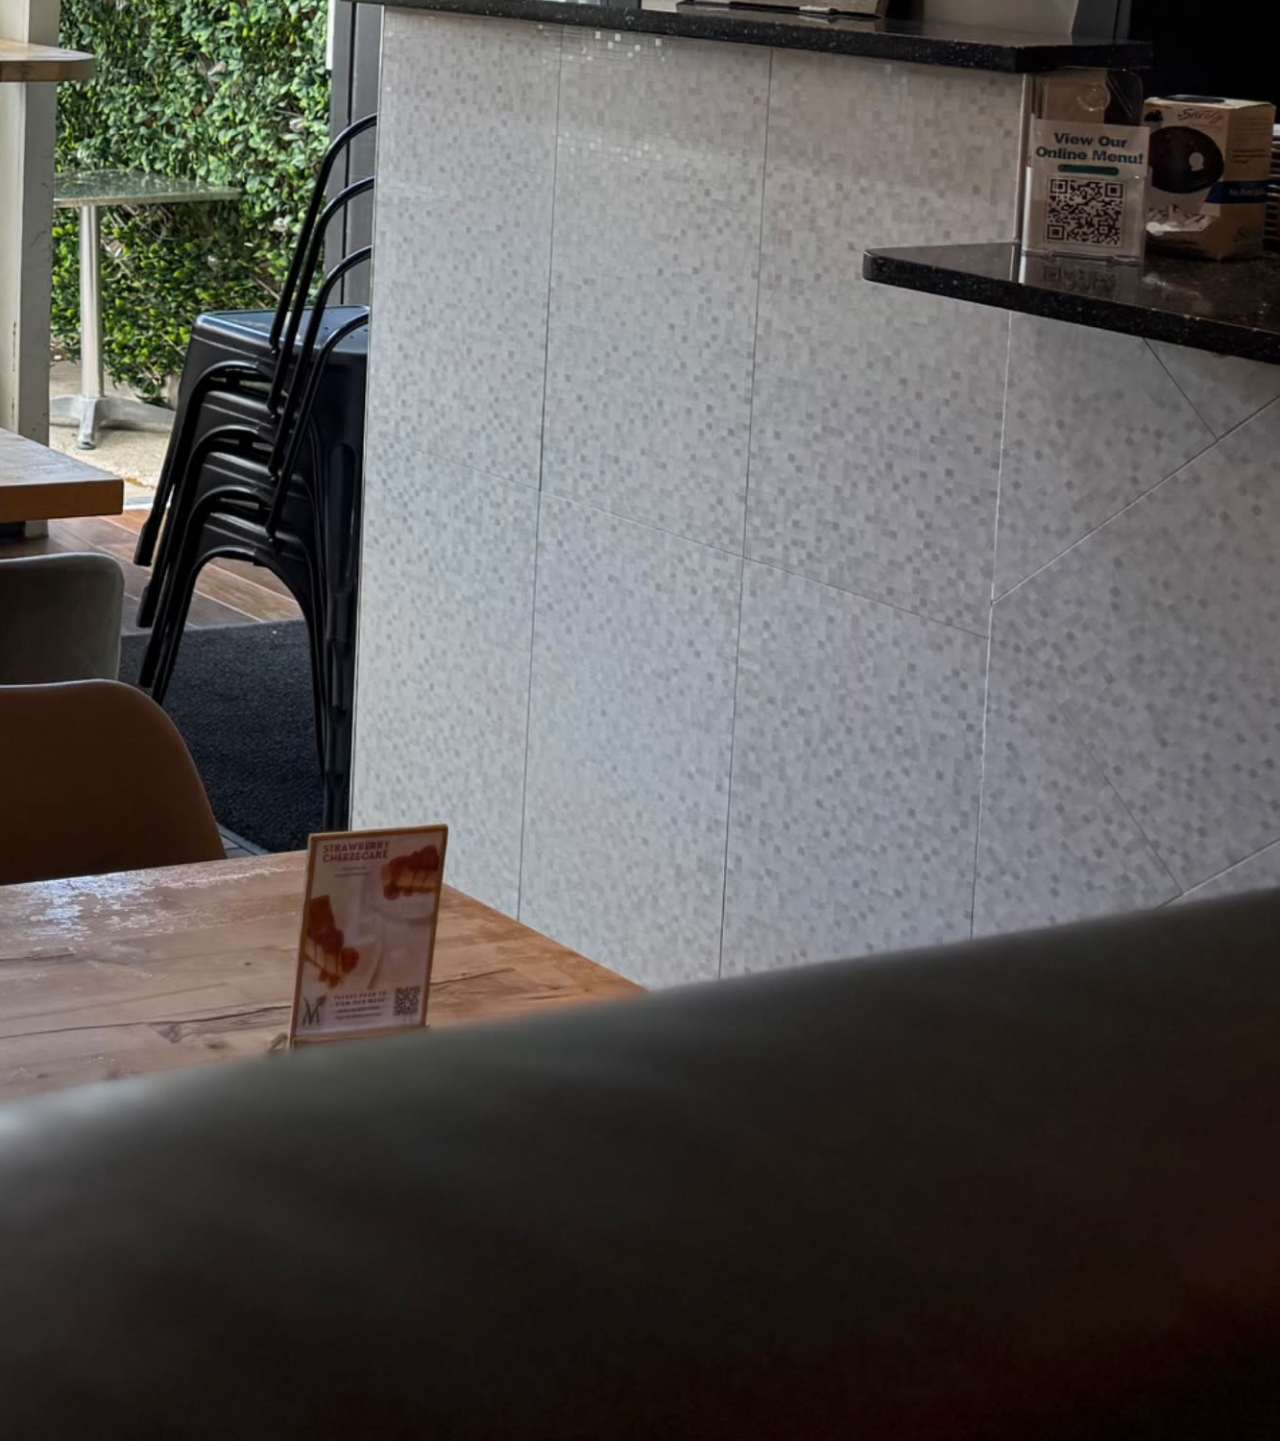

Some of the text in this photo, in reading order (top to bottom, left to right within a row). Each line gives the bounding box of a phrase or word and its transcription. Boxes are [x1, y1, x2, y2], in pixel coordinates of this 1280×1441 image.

[1054, 132, 1128, 149] View Our
[1036, 146, 1144, 165] Online Menu!
